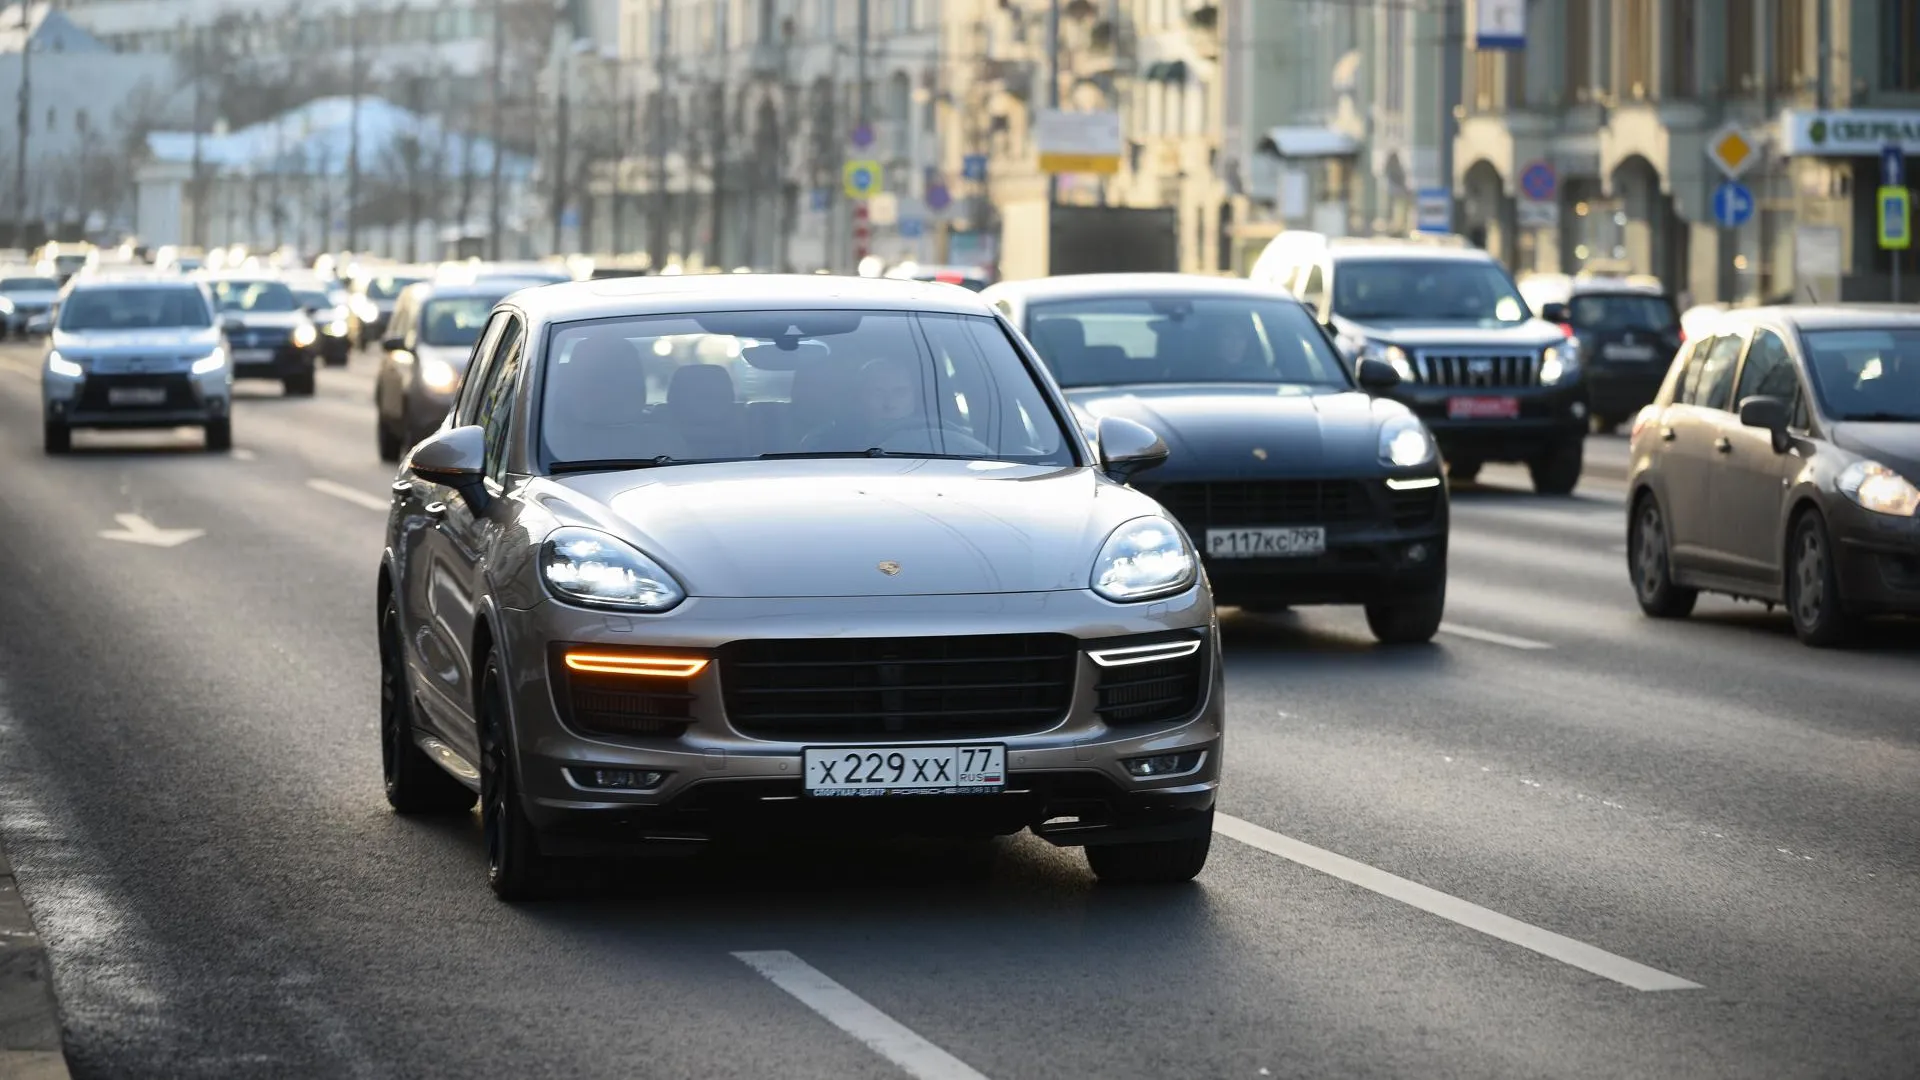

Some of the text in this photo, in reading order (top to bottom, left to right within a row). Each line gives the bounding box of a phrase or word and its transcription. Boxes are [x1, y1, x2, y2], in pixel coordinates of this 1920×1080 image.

[1832, 121, 1920, 142] СБЕРБА
[1292, 529, 1320, 545] 799
[961, 748, 992, 772] 77
[960, 773, 984, 782] RUS
